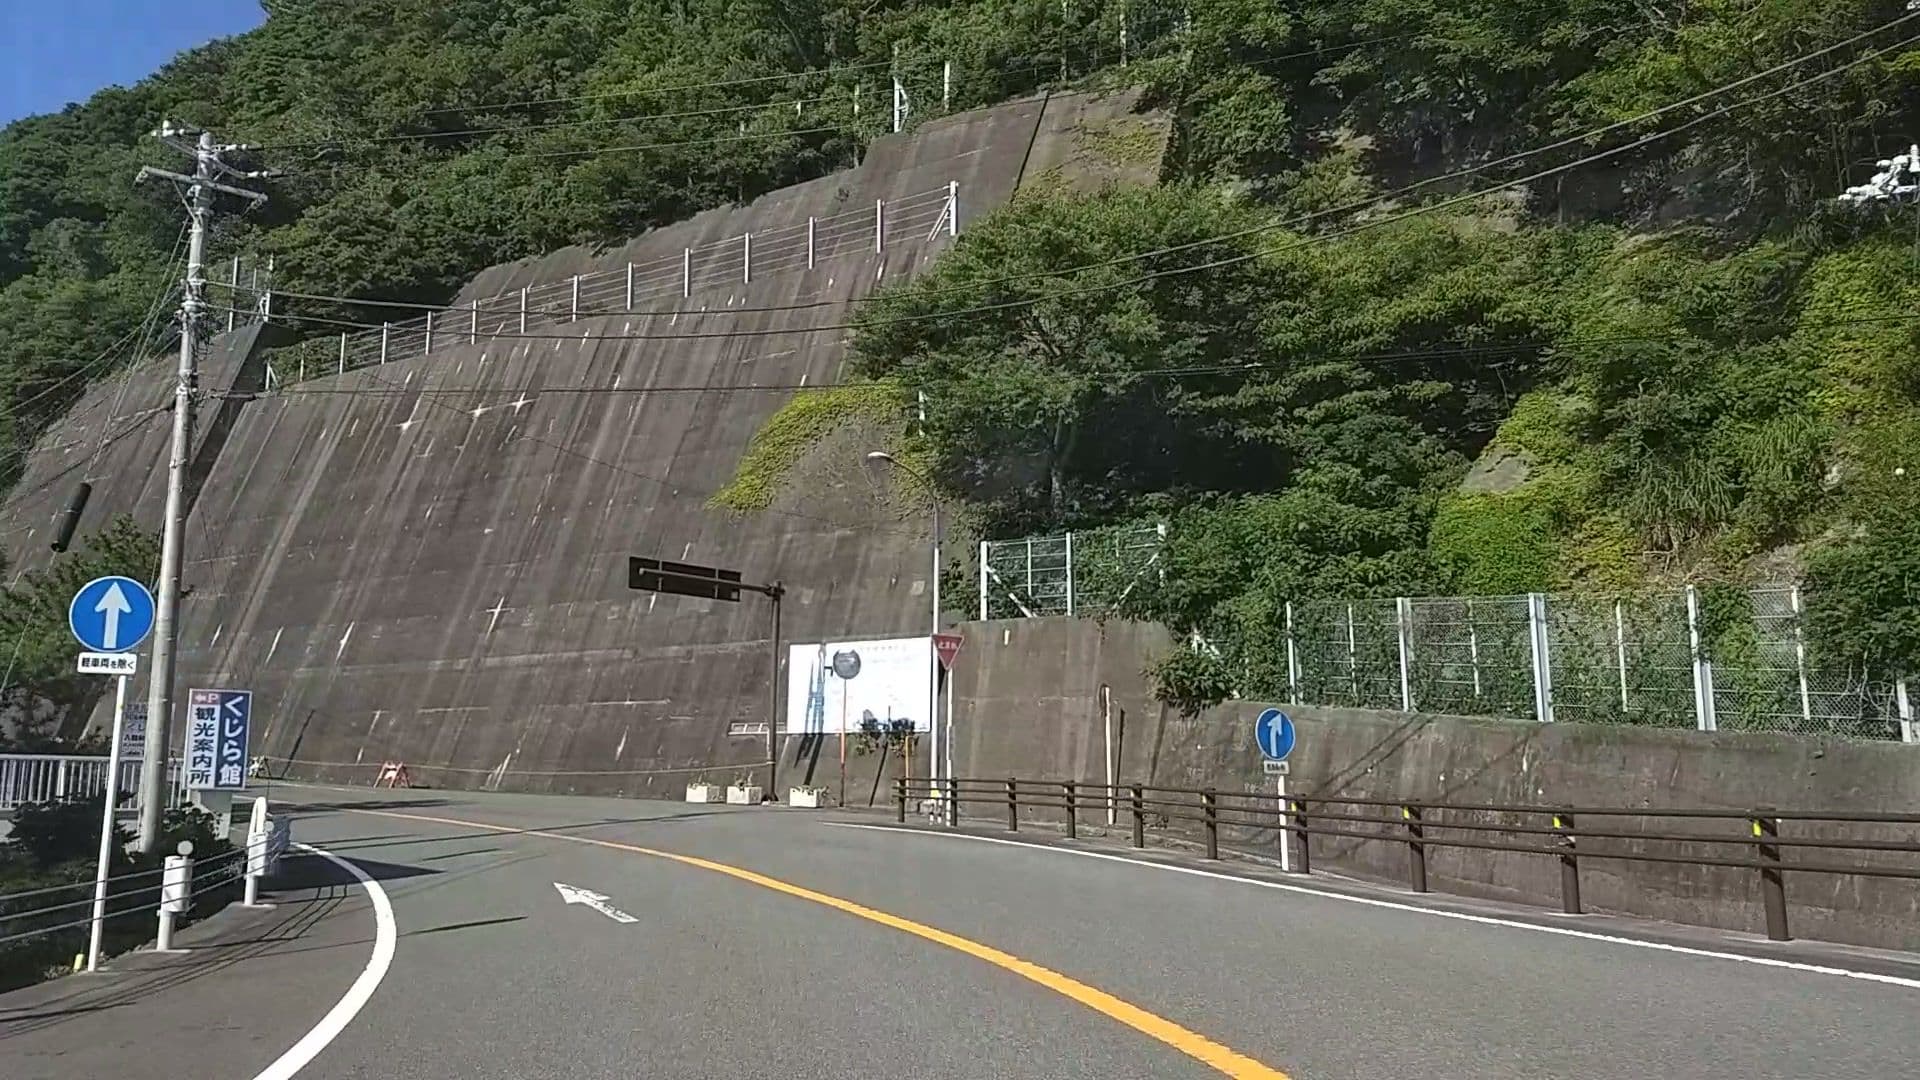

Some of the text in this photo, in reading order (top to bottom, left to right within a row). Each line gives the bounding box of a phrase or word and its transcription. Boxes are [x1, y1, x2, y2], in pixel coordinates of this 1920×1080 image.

[81, 657, 135, 669] 軽車両を除く
[207, 693, 219, 704] P
[190, 707, 216, 784] 観光案内所
[218, 695, 244, 785] くじら館
